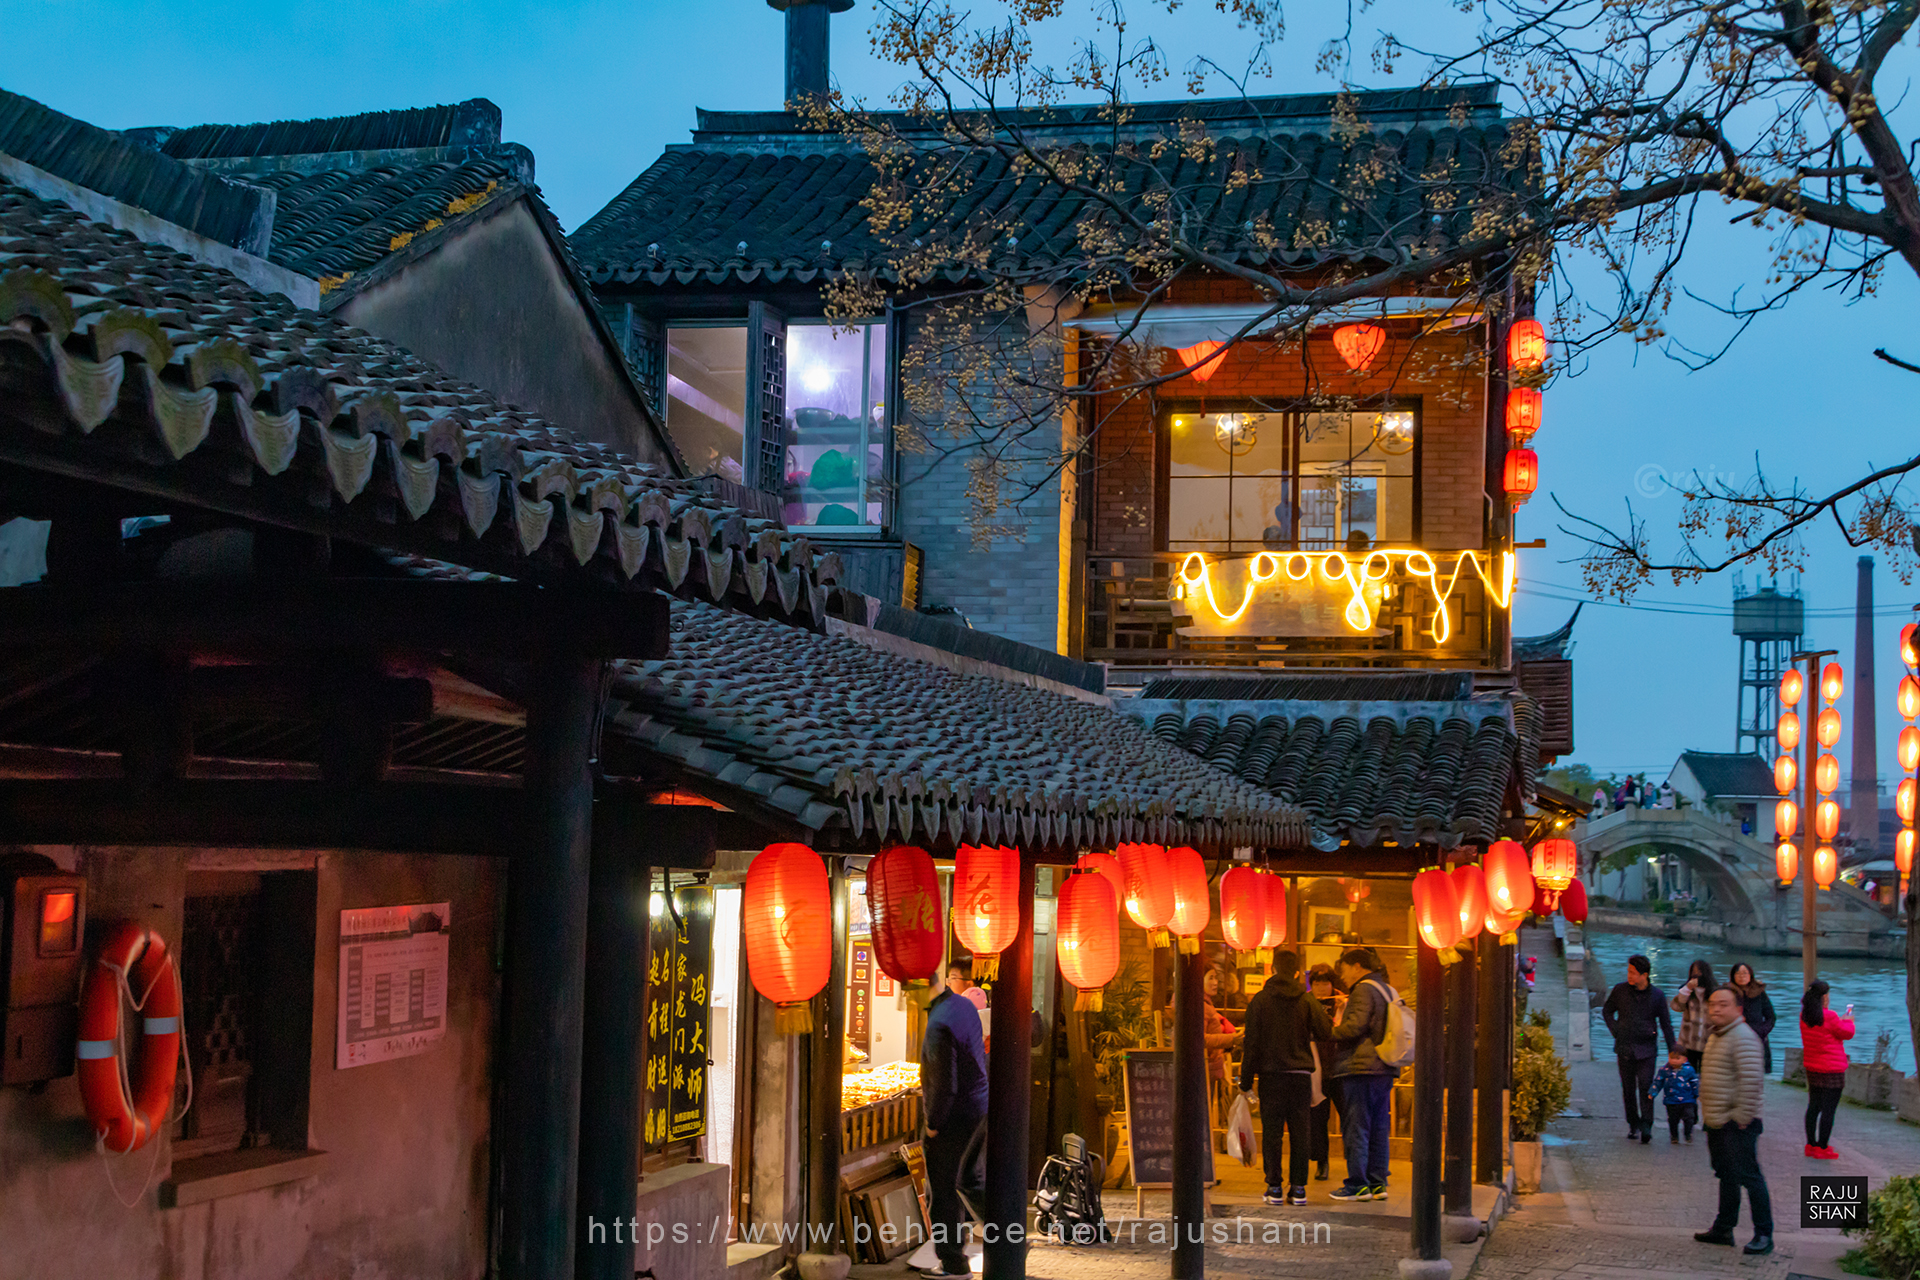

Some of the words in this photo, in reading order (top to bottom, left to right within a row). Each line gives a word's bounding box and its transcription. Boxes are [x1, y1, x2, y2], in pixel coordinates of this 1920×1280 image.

[964, 872, 999, 917] 花
[687, 972, 707, 1105] 冯大师
